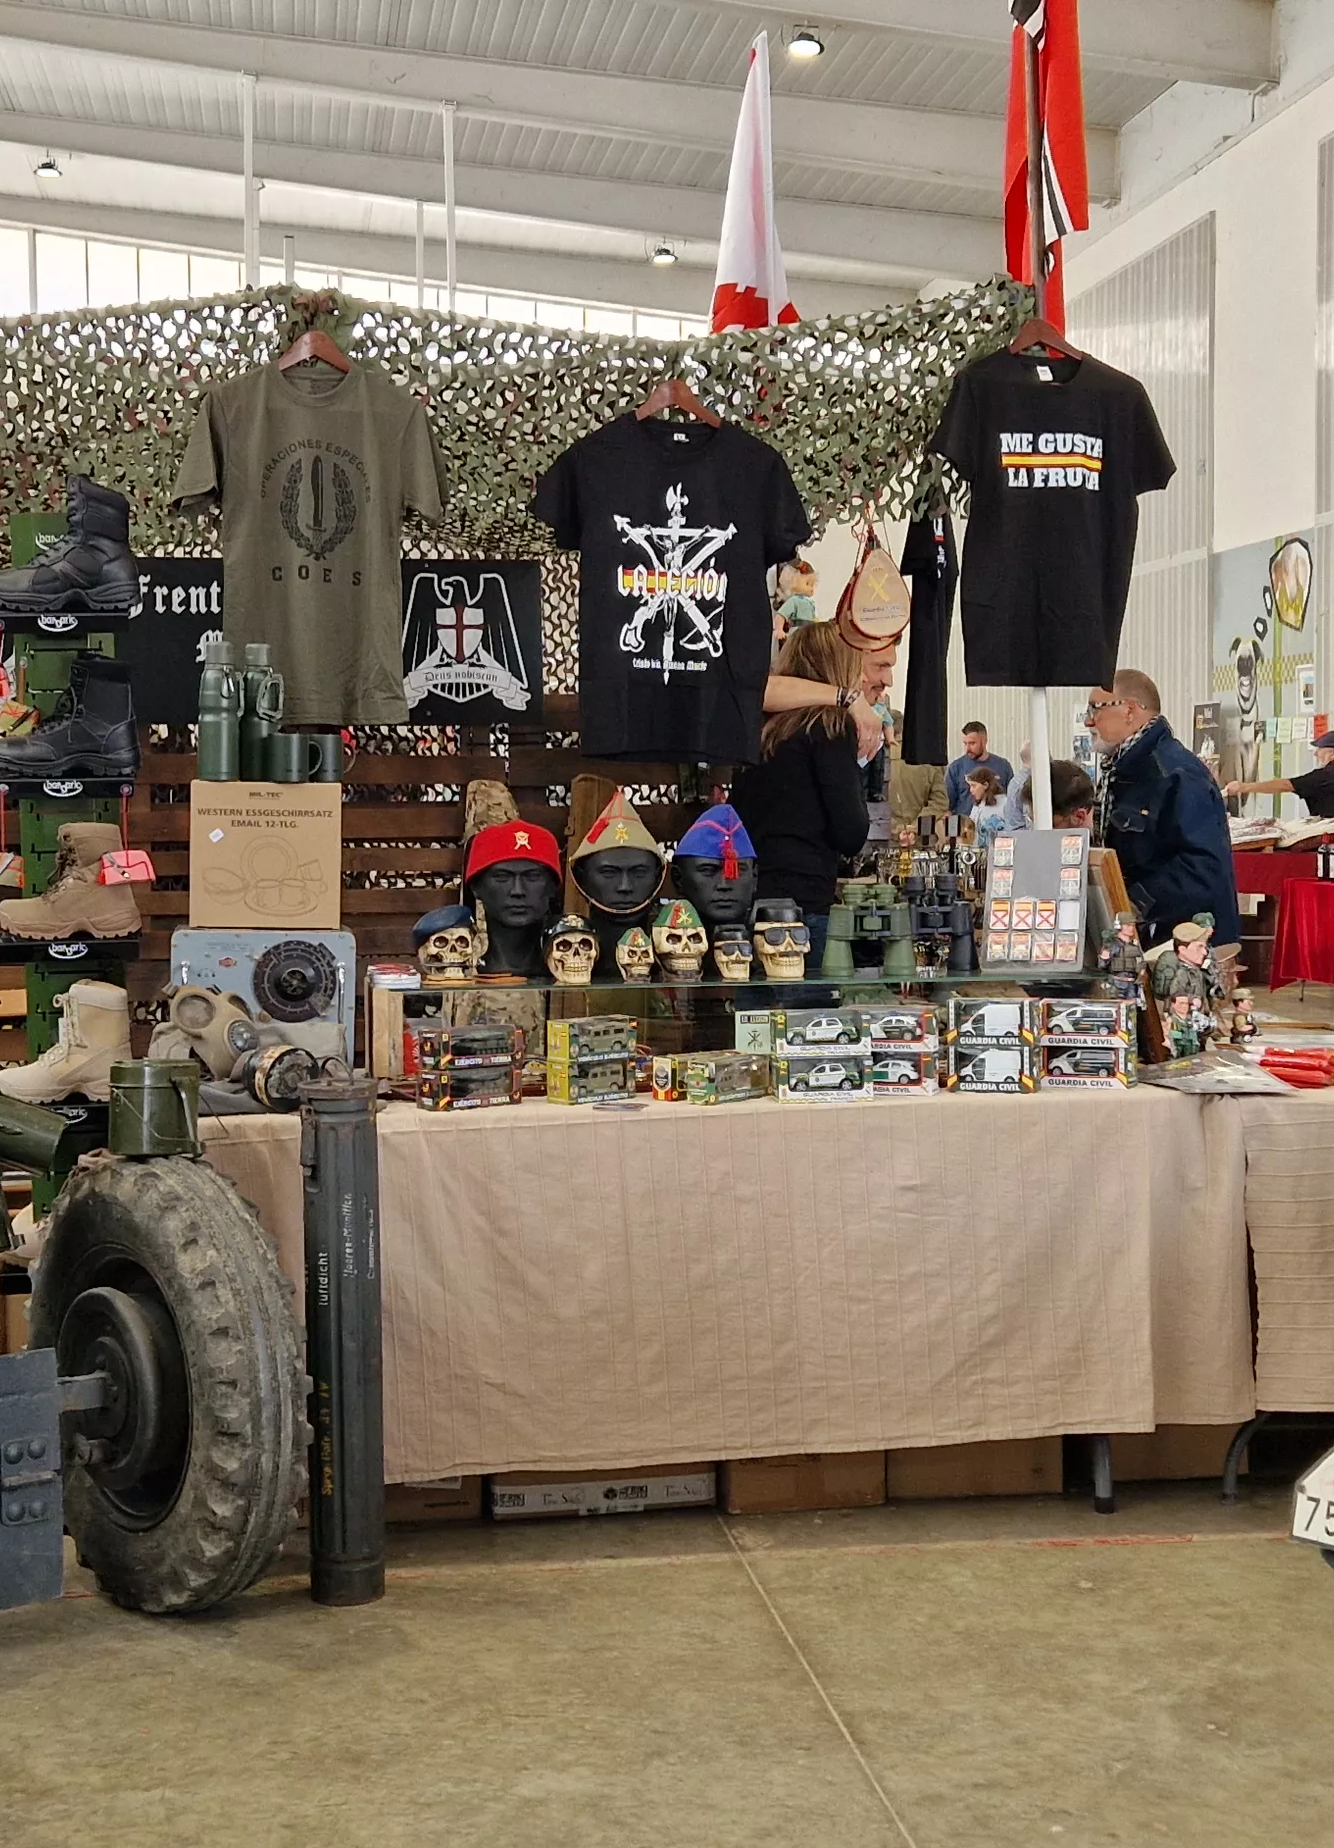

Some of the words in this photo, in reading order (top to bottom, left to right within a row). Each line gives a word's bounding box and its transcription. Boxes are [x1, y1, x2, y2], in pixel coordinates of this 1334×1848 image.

[999, 432, 1033, 453] ME
[1038, 432, 1103, 458] GUSTA
[1007, 467, 1029, 488] LA
[1032, 467, 1100, 491] FRUTA
[617, 563, 648, 598] LA
[424, 671, 452, 682] Deus
[197, 808, 243, 817] WESTERN
[245, 808, 334, 818] ESSGESCHIRRSATZ
[231, 819, 262, 828] EMAIL
[265, 820, 299, 829] 12-TLG.
[959, 1036, 998, 1046] GUARDIA
[999, 1036, 1021, 1046] CIVIL
[1047, 1037, 1088, 1046] GUARDIA
[1090, 1037, 1115, 1046] CIVIL
[959, 1082, 998, 1091] GUARDIA
[999, 1082, 1021, 1091] CIVIL
[1047, 1079, 1087, 1087] GUARDIA
[1089, 1080, 1114, 1088] CIVIL
[318, 1251, 329, 1307] luftdicht
